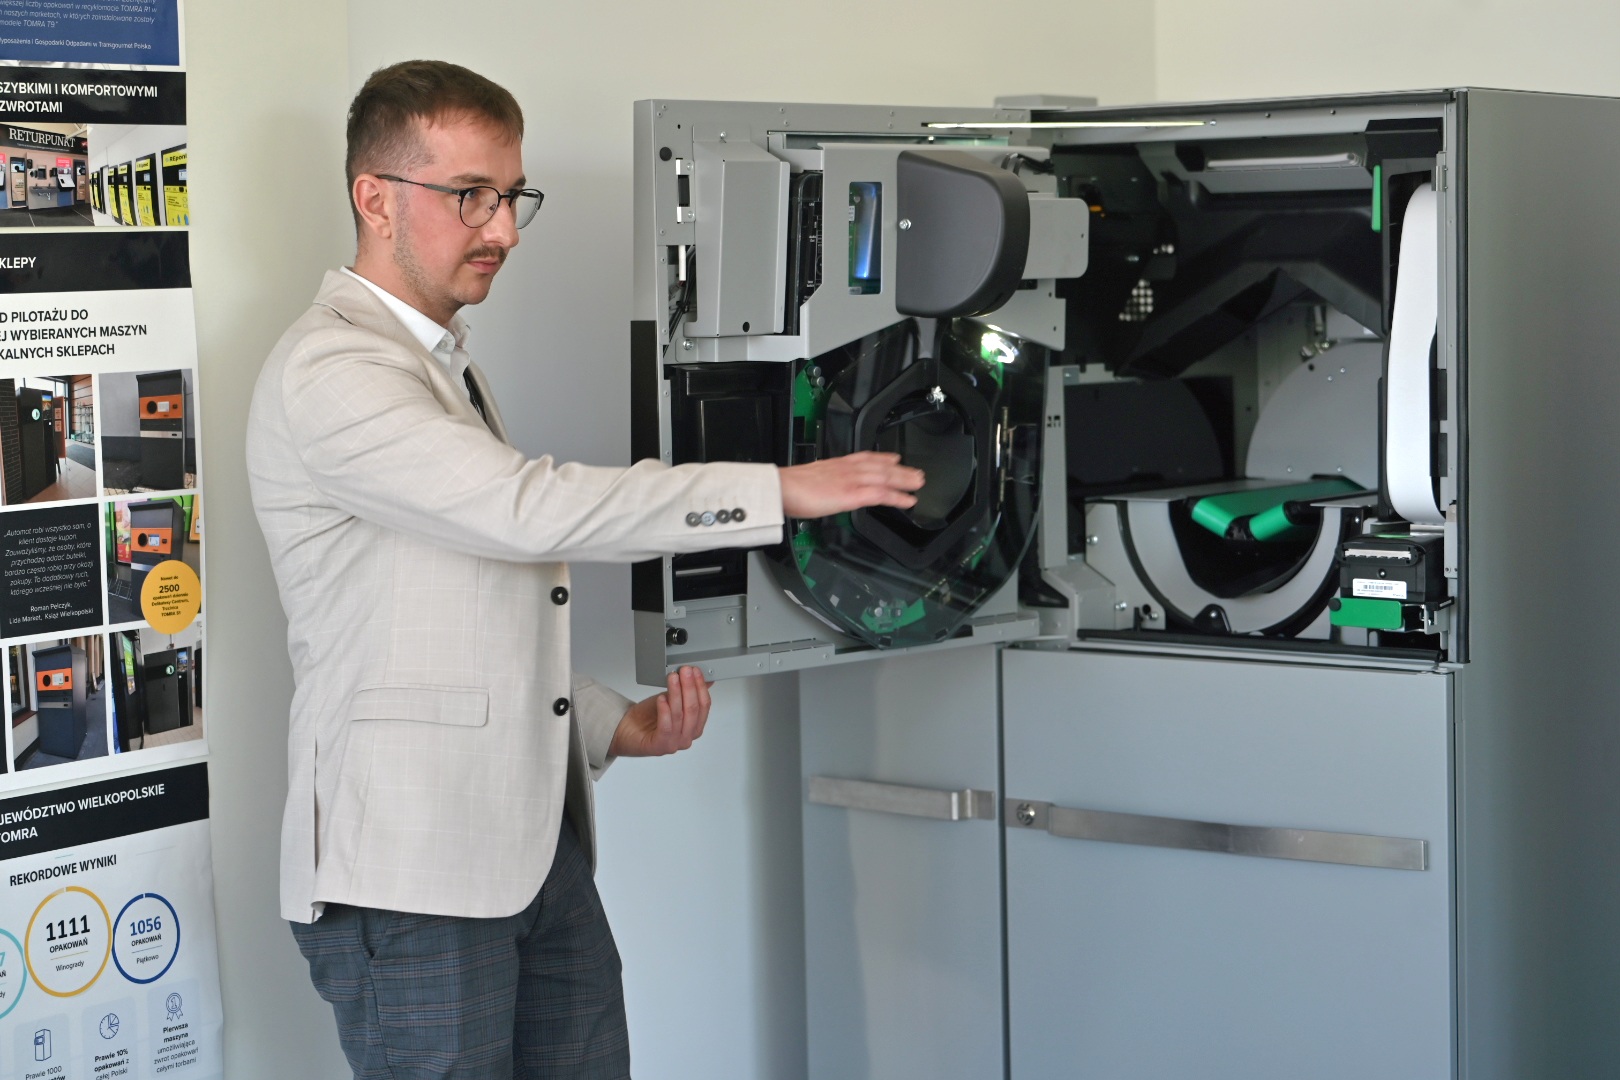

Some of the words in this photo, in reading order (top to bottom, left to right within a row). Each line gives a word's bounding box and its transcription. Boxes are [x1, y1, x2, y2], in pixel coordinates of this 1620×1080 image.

[0, 37, 31, 45] yposażenia
[99, 41, 133, 49] Transgourmet
[0, 81, 52, 95] SZYBKIMI
[55, 84, 59, 95] I
[61, 83, 158, 98] KOMFORTOWYMI
[0, 100, 63, 113] ZWROTAMI
[9, 127, 76, 148] RETURPUNKT
[0, 256, 37, 269] KLEPY
[11, 307, 68, 323] PILOTAŻU
[71, 309, 89, 321] DO
[10, 326, 97, 341] WYBIERANYCH
[100, 324, 148, 338] MASZYN
[56, 343, 115, 357] SKLEPACH
[32, 526, 44, 534] robi
[45, 524, 72, 533] wszystko
[18, 537, 35, 546] klient
[35, 535, 57, 544] dostaje
[76, 541, 92, 549] które
[10, 556, 46, 568] przychodzą
[46, 553, 65, 562] oddać
[4, 568, 26, 577] bardzo
[26, 565, 46, 575] często
[63, 562, 77, 571] przy
[76, 560, 94, 569] okazji
[41, 572, 75, 582] dodatkowy
[10, 586, 34, 596] którego
[34, 584, 63, 592] wcześniej
[63, 582, 73, 590] nie
[159, 584, 180, 593] 2500
[22, 614, 43, 623] Market,
[44, 612, 59, 621] Książ
[60, 608, 94, 618] Wielkopolski
[30, 604, 50, 613] Roman
[0, 801, 75, 826] JEWÓDZTWO
[77, 783, 165, 811] WIELKOPOLSKIE
[0, 826, 39, 843] OMRA
[10, 862, 78, 887] REKORDOWE
[79, 854, 117, 873] WYNIKI
[46, 914, 90, 942] 1111
[130, 916, 162, 936] 1056
[49, 936, 89, 954] OPAKOWAŃ
[131, 933, 162, 947] OPAKOWAŃ
[136, 953, 160, 964] Piątkowo
[56, 960, 85, 972] Winogrady
[162, 1022, 189, 1034] Pierwsza
[163, 1032, 189, 1043] maszyna
[157, 1039, 196, 1055] umożliwiająca
[94, 1052, 116, 1062] Prawie
[116, 1048, 129, 1058] 10%
[153, 1055, 170, 1065] zwrot
[170, 1047, 199, 1061] opakowań
[94, 1060, 125, 1072] opakowań
[156, 1063, 175, 1073] całymi
[175, 1057, 197, 1068] torbami
[25, 1070, 46, 1080] Prawie
[46, 1065, 63, 1075] 1000
[110, 1068, 128, 1077] Polski
